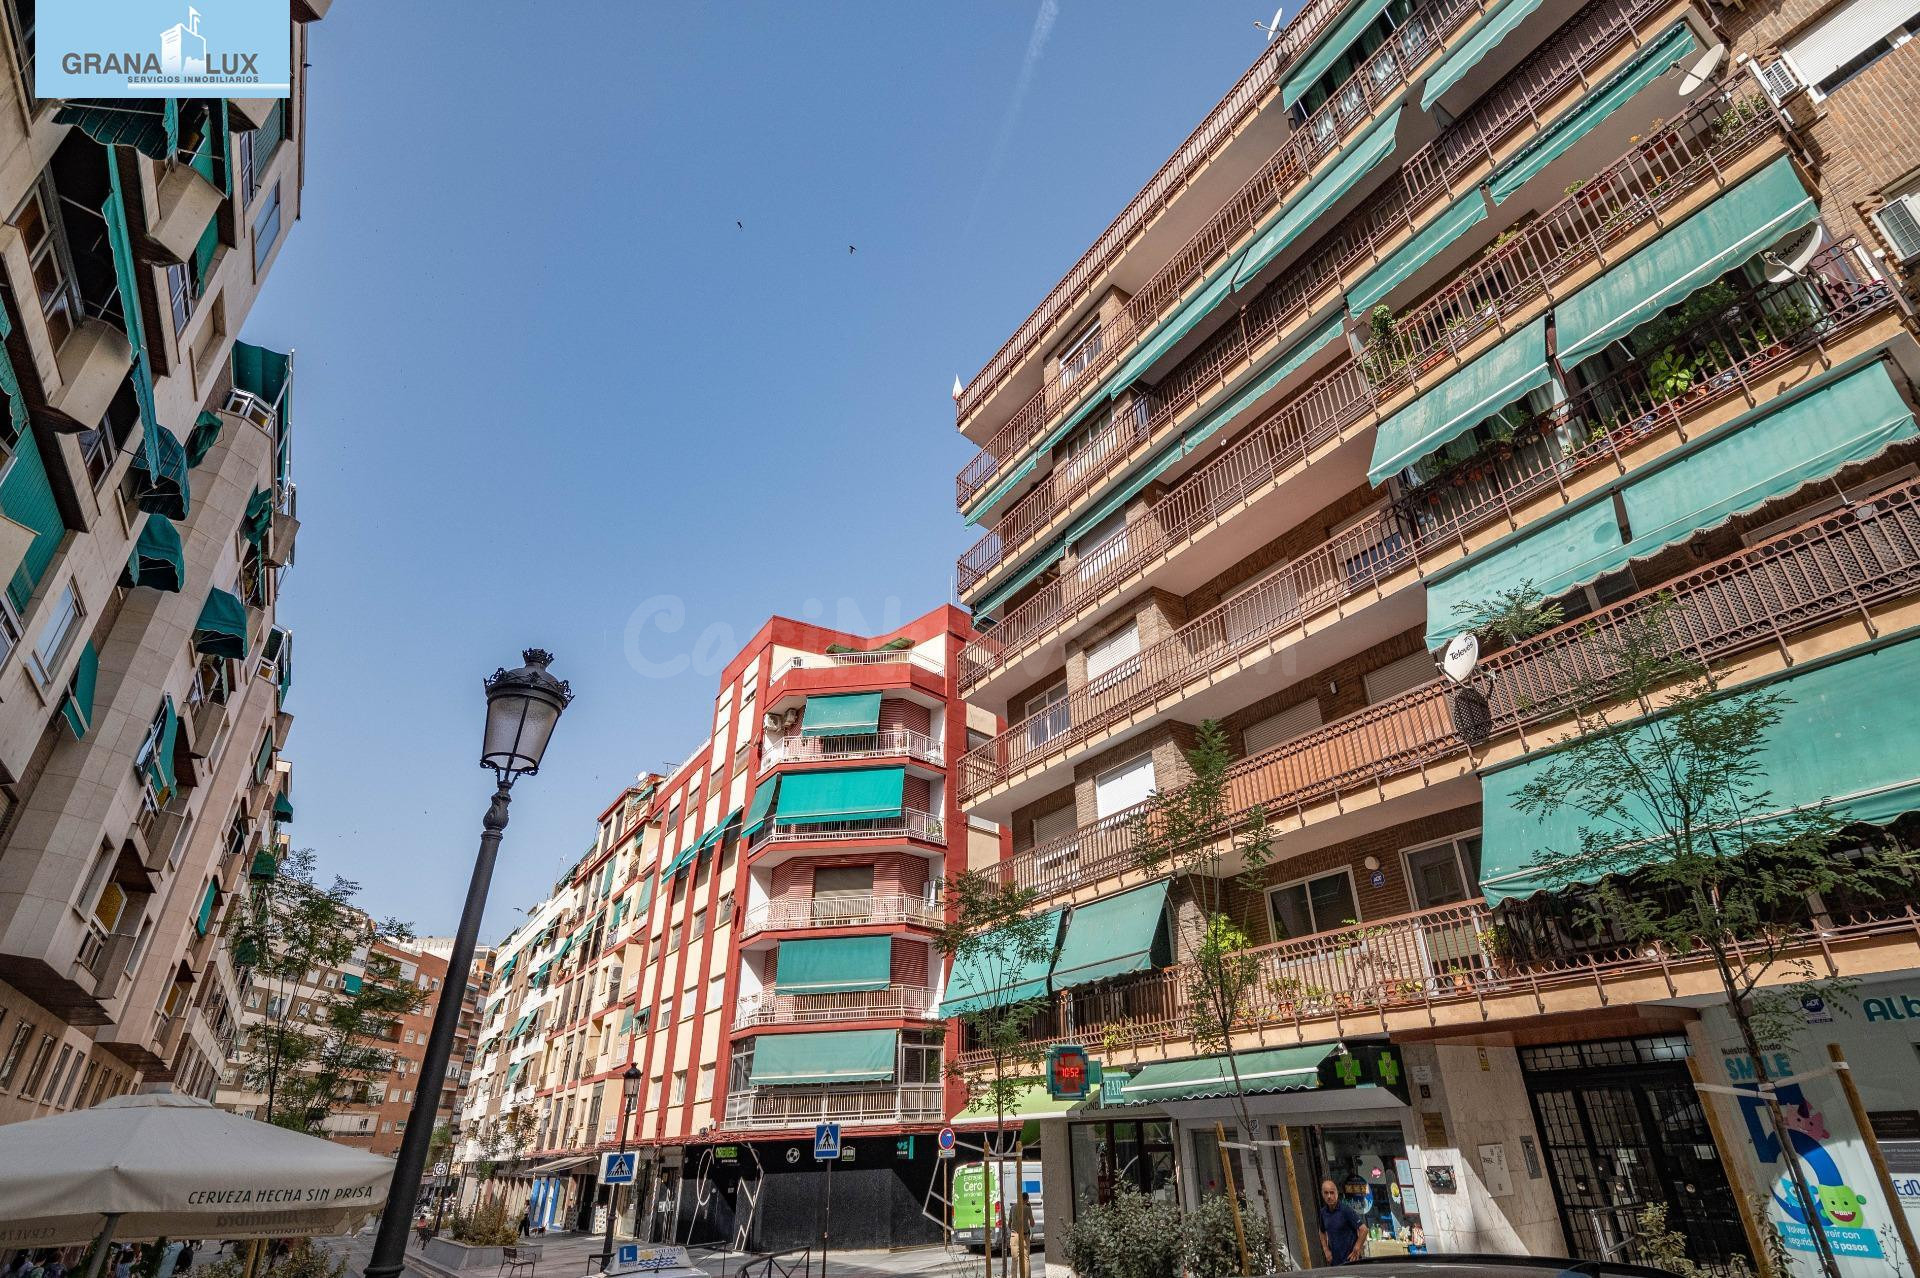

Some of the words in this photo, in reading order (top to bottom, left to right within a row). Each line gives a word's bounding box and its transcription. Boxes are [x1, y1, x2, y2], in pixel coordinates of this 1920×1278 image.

[1724, 1052, 1794, 1081] SMLE
[1062, 1067, 1079, 1078] 10:52
[963, 1181, 983, 1192] Cero
[187, 1190, 252, 1205] CERVEZA
[255, 1188, 301, 1203] HECHA
[306, 1187, 330, 1202] SIN
[334, 1185, 373, 1200] PRISA
[1842, 1231, 1861, 1240] con
[1840, 1242, 1870, 1253] pasos
[623, 1247, 633, 1261] L
